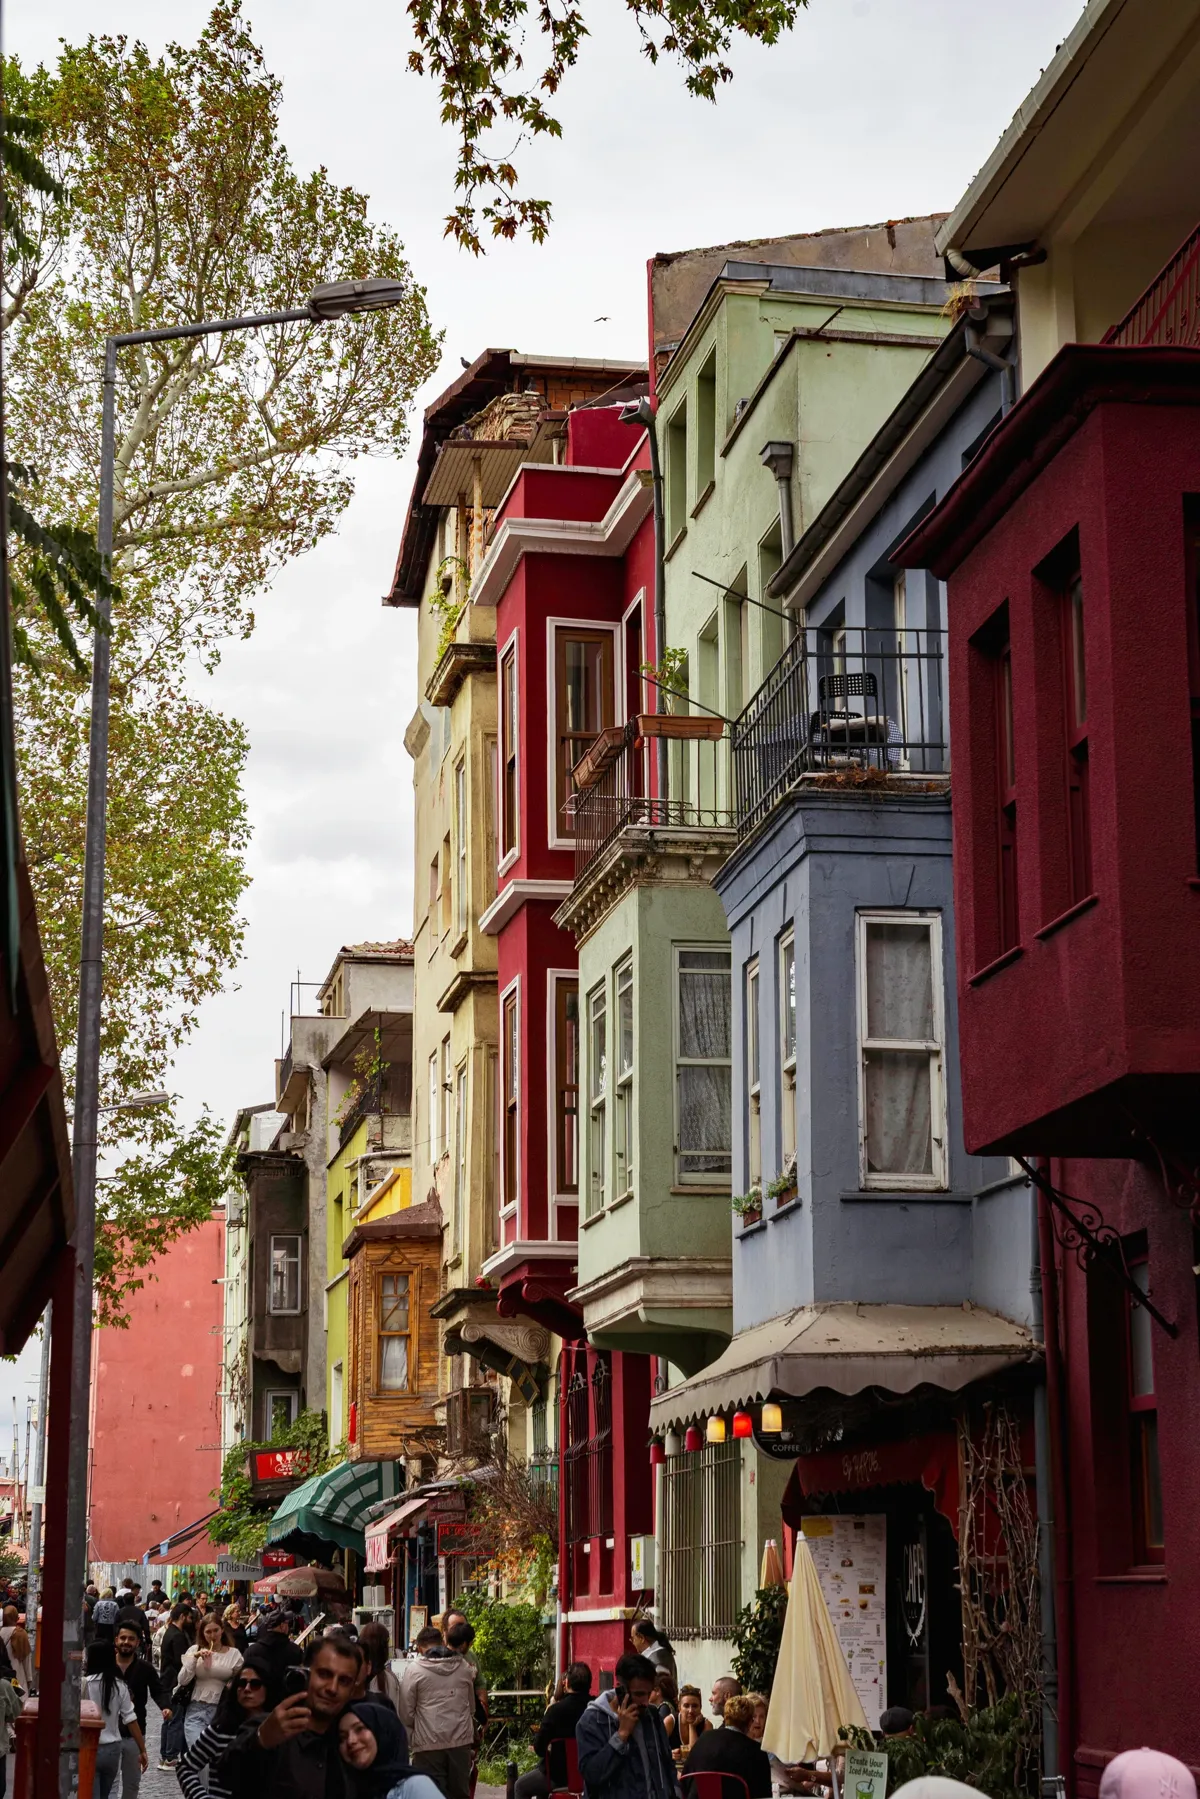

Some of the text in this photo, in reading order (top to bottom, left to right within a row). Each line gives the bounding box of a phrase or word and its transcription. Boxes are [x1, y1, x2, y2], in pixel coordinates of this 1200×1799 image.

[772, 1444, 800, 1452] COFFEE
[849, 1756, 884, 1769] Create Your
[848, 1765, 884, 1779] Iced Matcha
